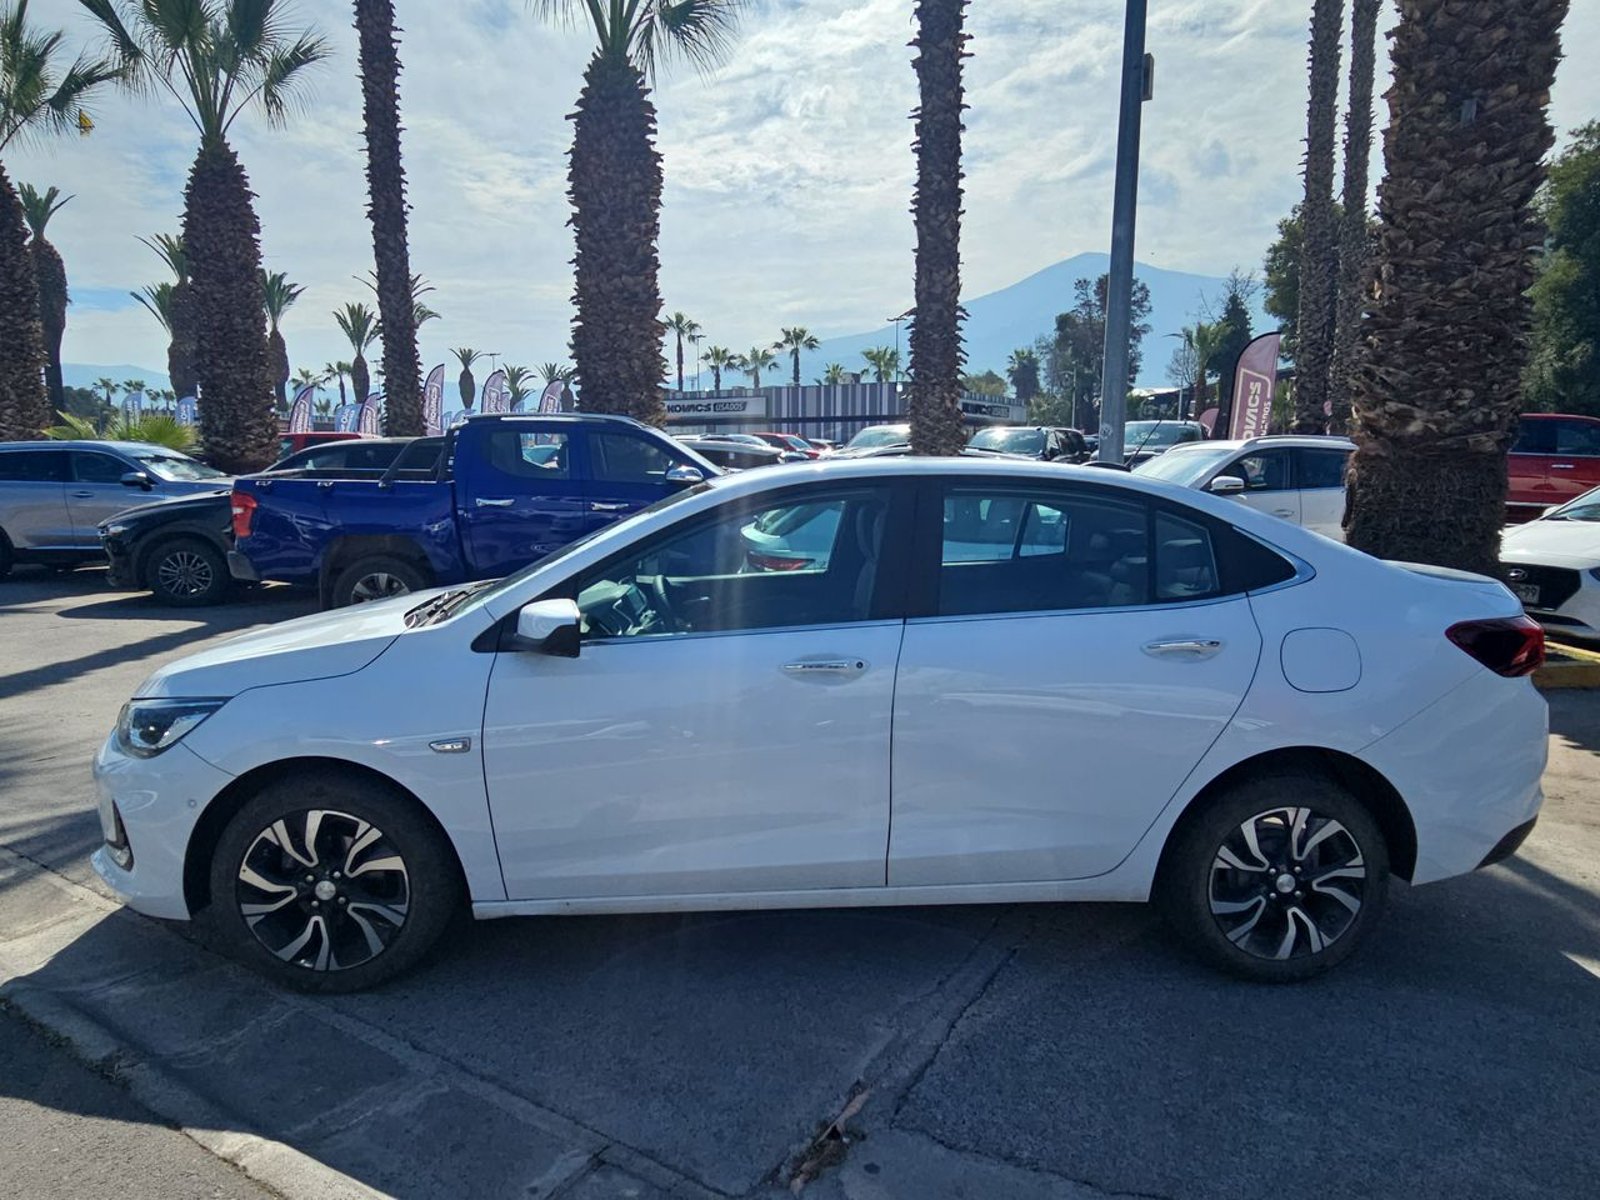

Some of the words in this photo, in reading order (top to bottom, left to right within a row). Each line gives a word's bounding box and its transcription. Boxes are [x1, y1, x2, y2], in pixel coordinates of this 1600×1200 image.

[667, 403, 711, 413] KOVACS
[714, 401, 744, 412] USADOS
[1242, 382, 1262, 440] OVACS
